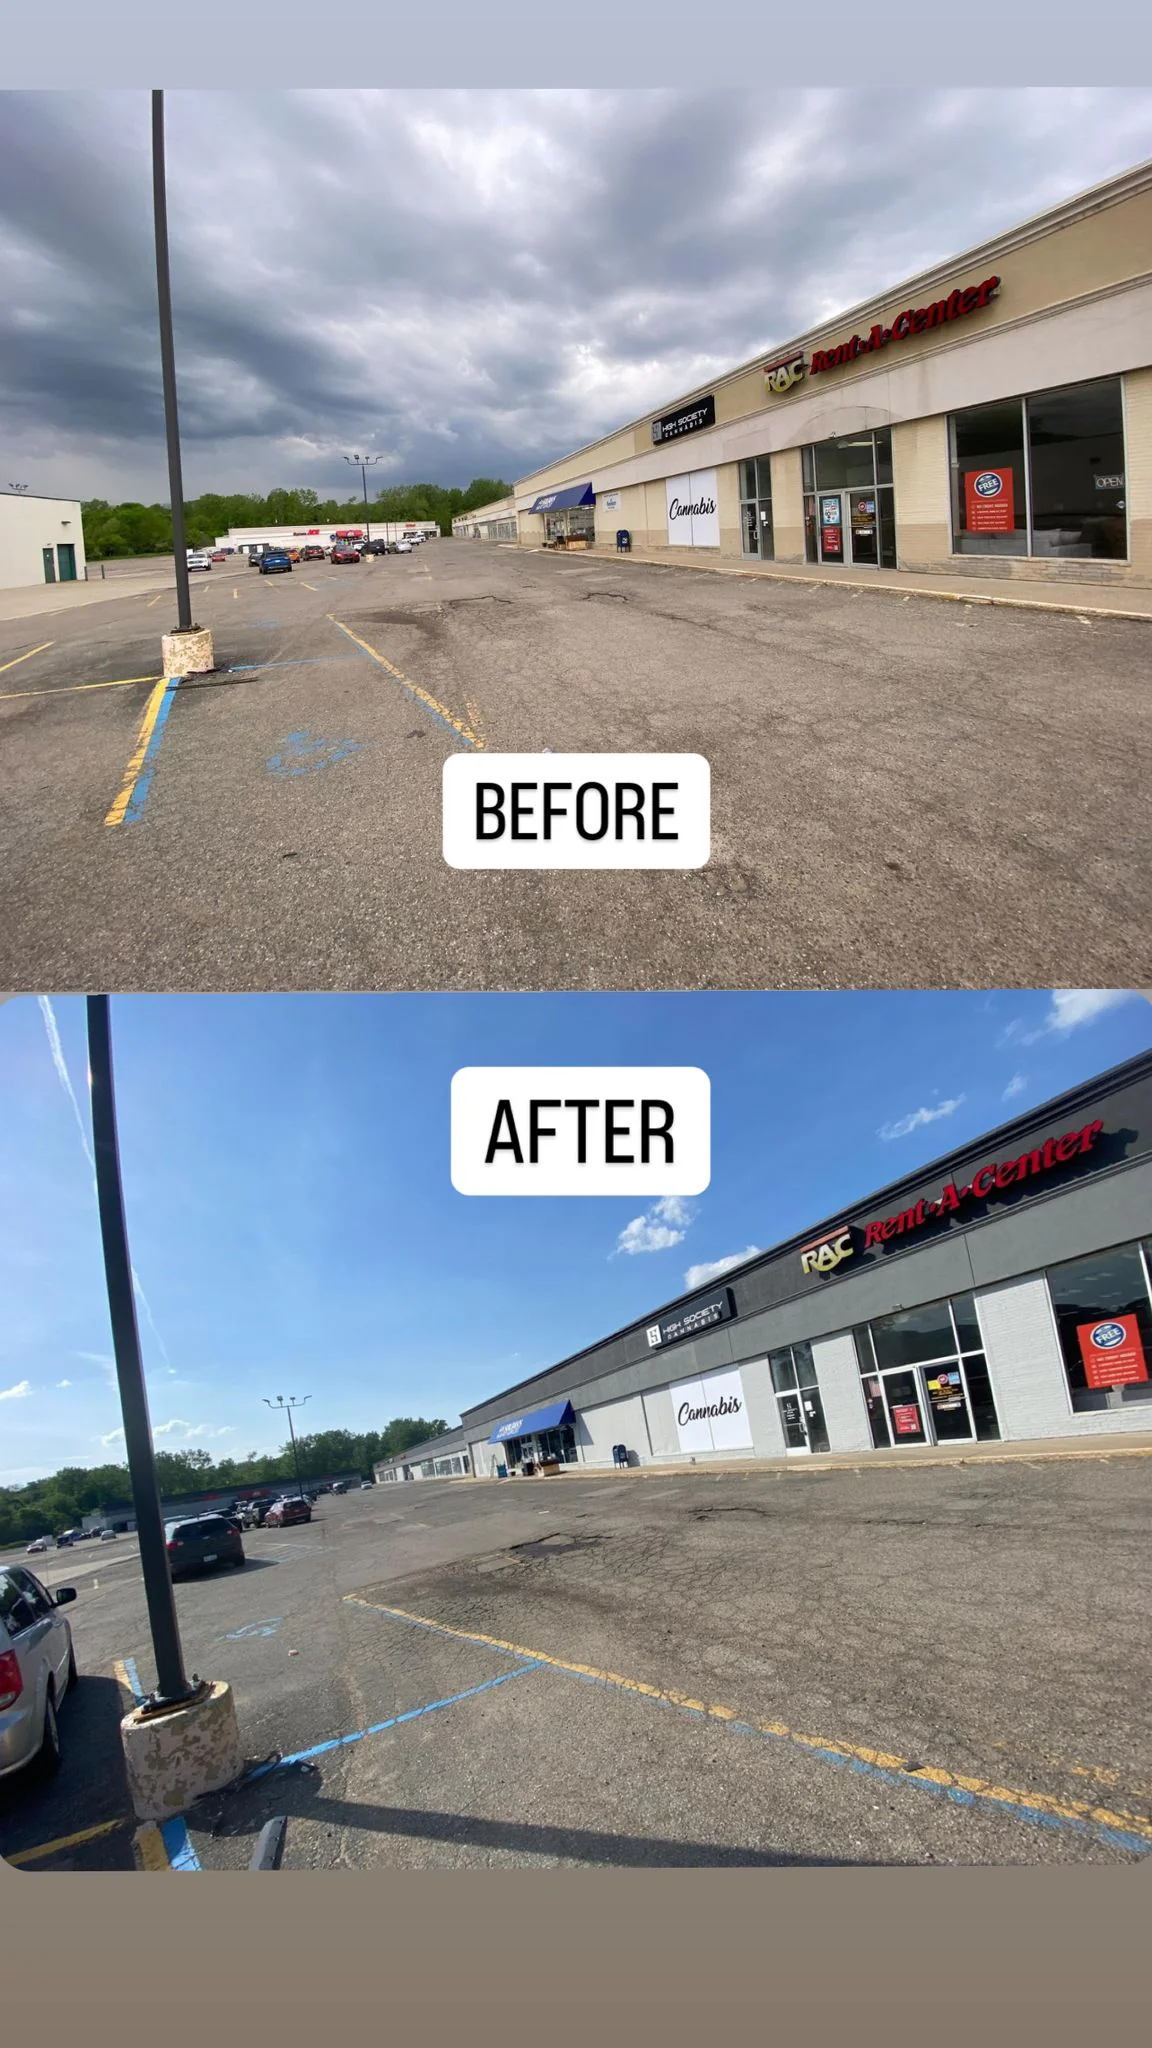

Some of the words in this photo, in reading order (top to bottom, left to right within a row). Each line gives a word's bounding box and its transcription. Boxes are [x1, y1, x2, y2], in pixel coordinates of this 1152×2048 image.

[764, 357, 806, 393] RAC
[677, 407, 708, 426] SOCIETY
[978, 477, 999, 492] FREE
[669, 497, 717, 521] Cannabis
[801, 1234, 854, 1275] RAC
[683, 1301, 723, 1325] SOCIETY
[1095, 1327, 1122, 1343] FREE
[678, 1396, 742, 1427] Cannabis
